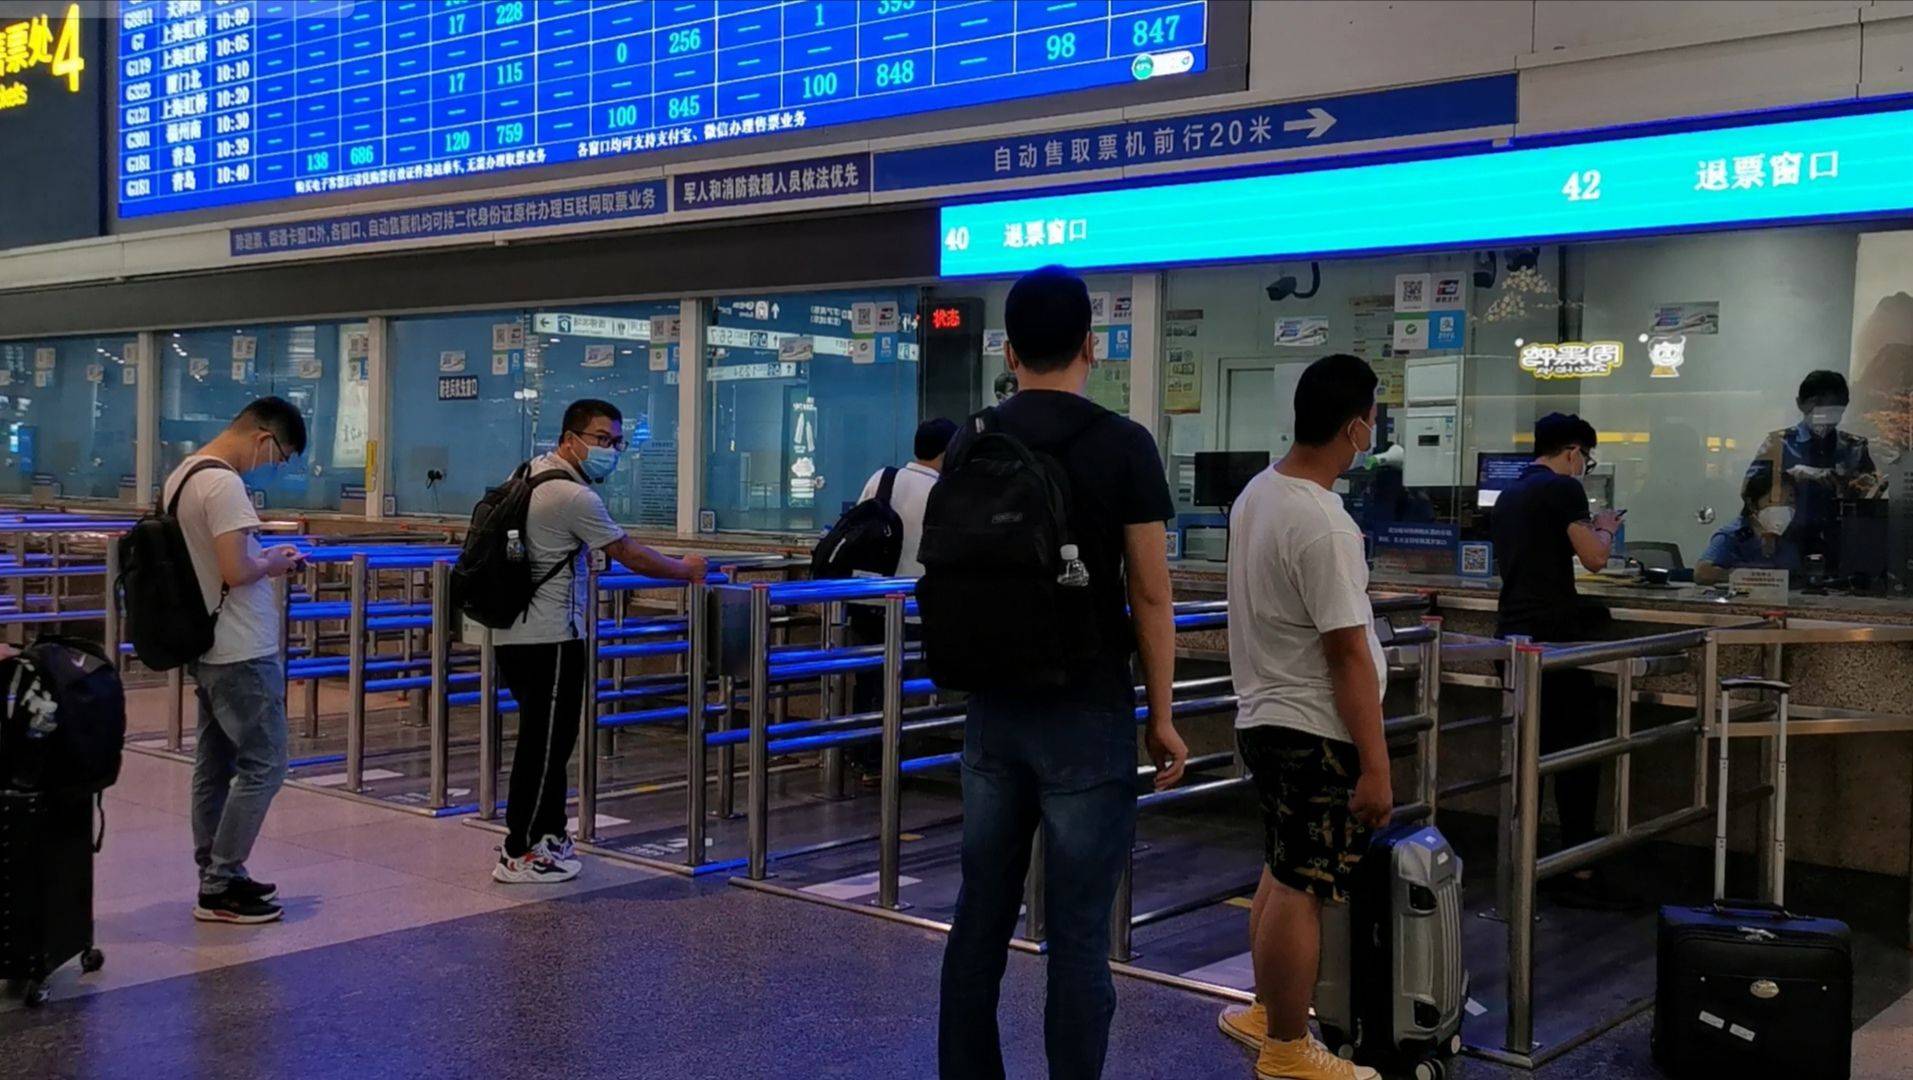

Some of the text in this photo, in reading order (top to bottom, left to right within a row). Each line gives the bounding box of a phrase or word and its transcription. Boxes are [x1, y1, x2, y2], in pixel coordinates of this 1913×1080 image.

[0, 3, 84, 92] 票处 4
[161, 15, 208, 44] 上海虹桥
[216, 60, 250, 82] 10:10
[449, 13, 466, 35] 17
[496, 1, 524, 25] 228
[161, 41, 208, 70] 上海虹桥
[216, 33, 250, 57] 10:05
[216, 111, 250, 133] 10:30
[449, 72, 466, 94] 17
[496, 62, 523, 85] 115
[616, 42, 628, 64] 0
[669, 28, 701, 54] 256
[814, 3, 825, 27] 1
[161, 91, 208, 119] 上海虹桥
[216, 86, 250, 108] 10:20
[172, 169, 196, 192] 青岛
[216, 163, 250, 184] 10:40
[307, 151, 329, 171] 138
[350, 145, 374, 166] 686
[445, 131, 470, 152] 120
[496, 122, 524, 144] 759
[608, 105, 637, 128] 100
[668, 95, 701, 119] 845
[803, 72, 838, 99] 100
[876, 59, 914, 87] 848
[1046, 32, 1076, 61] 98
[1132, 14, 1180, 47] 847
[577, 110, 807, 158] 各窗口均可支持支付宝、微信办理售票业务
[994, 115, 1272, 172] 自动售取票机前行20米
[172, 145, 196, 167] 青岛
[1693, 150, 1840, 192] 退票窗口
[683, 162, 859, 204] 军人和消防救援人员依法优先
[1562, 169, 1602, 201] 42
[944, 226, 970, 251] 40
[1003, 217, 1088, 248] 退票窗口
[932, 308, 961, 329] 状态
